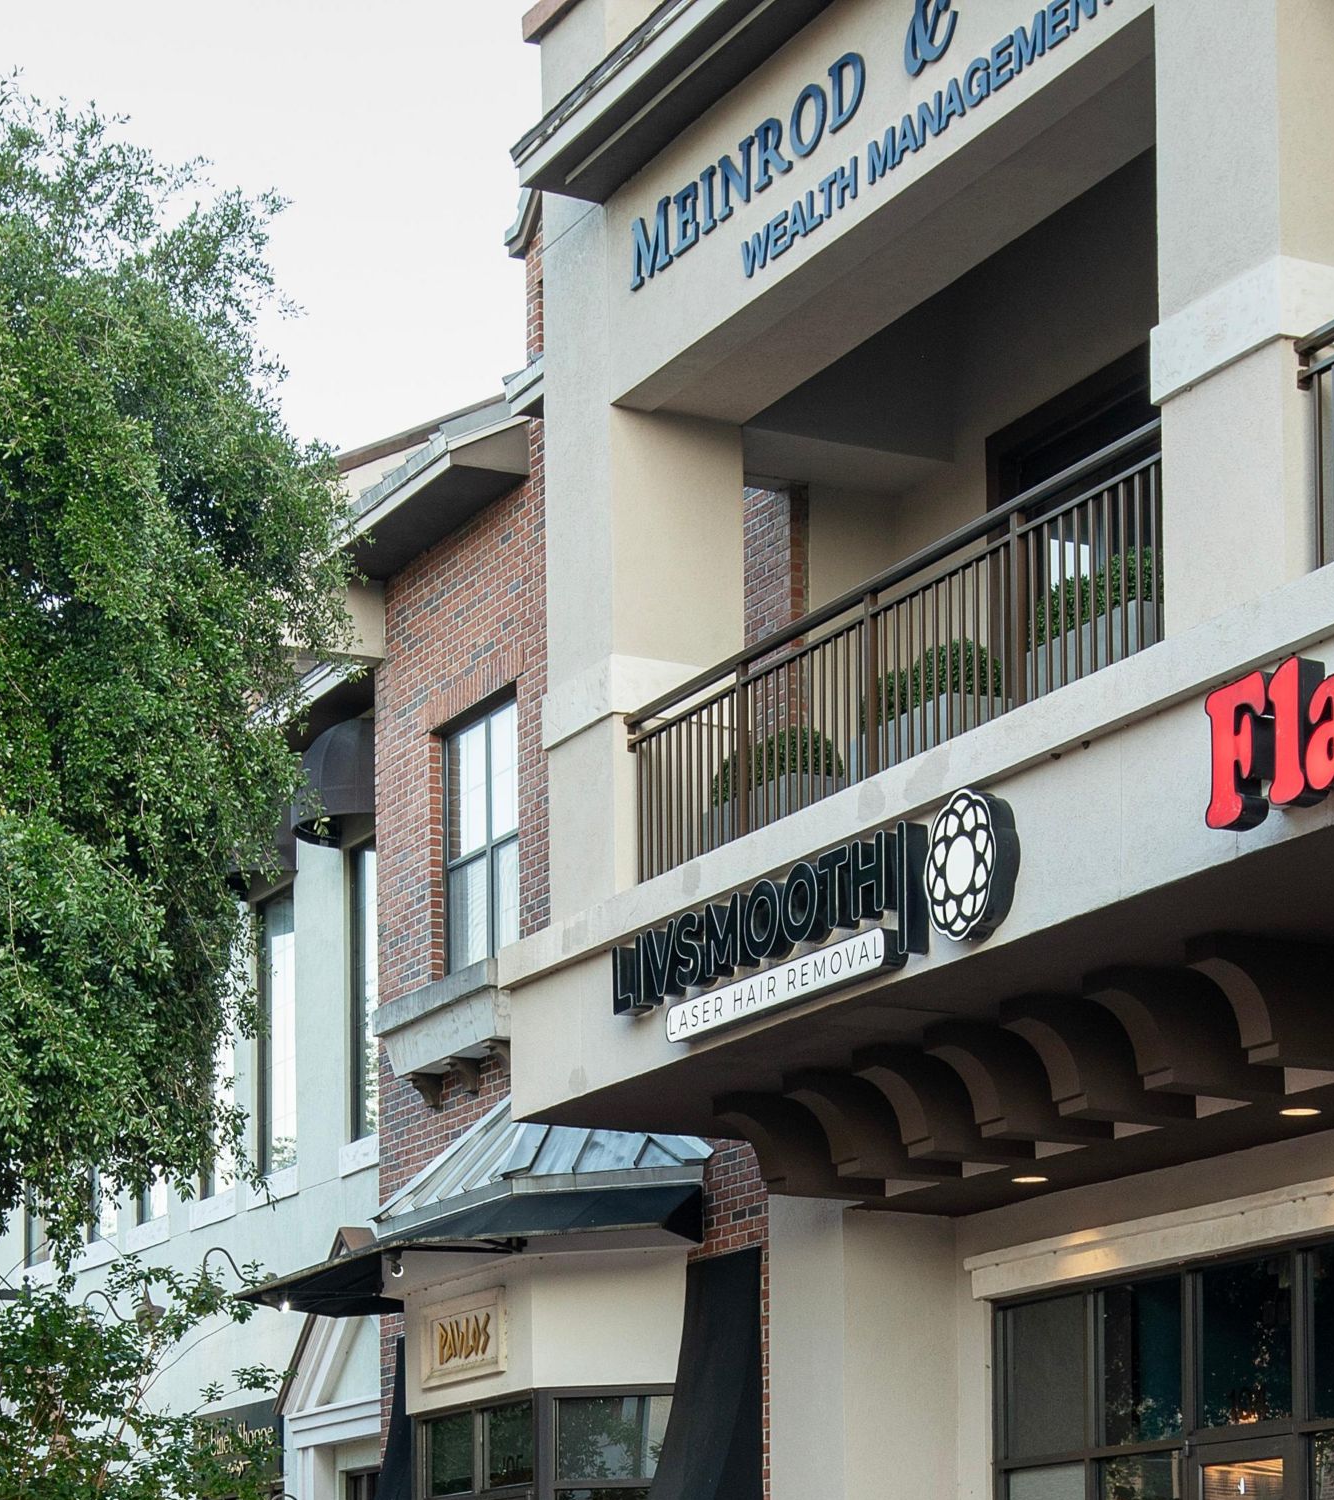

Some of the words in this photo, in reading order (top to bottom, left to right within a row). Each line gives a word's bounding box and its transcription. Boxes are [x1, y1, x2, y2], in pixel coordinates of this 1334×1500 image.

[630, 52, 866, 291] MEINROD
[740, 155, 860, 279] WEALTH
[867, 0, 1115, 184] MANAGEMEN
[612, 829, 887, 1017] LIVSMOOTH
[668, 1001, 723, 1036] LASER
[733, 976, 777, 1013] HAIR
[787, 935, 883, 992] REMOVAL
[437, 1312, 491, 1366] PAVLOS
